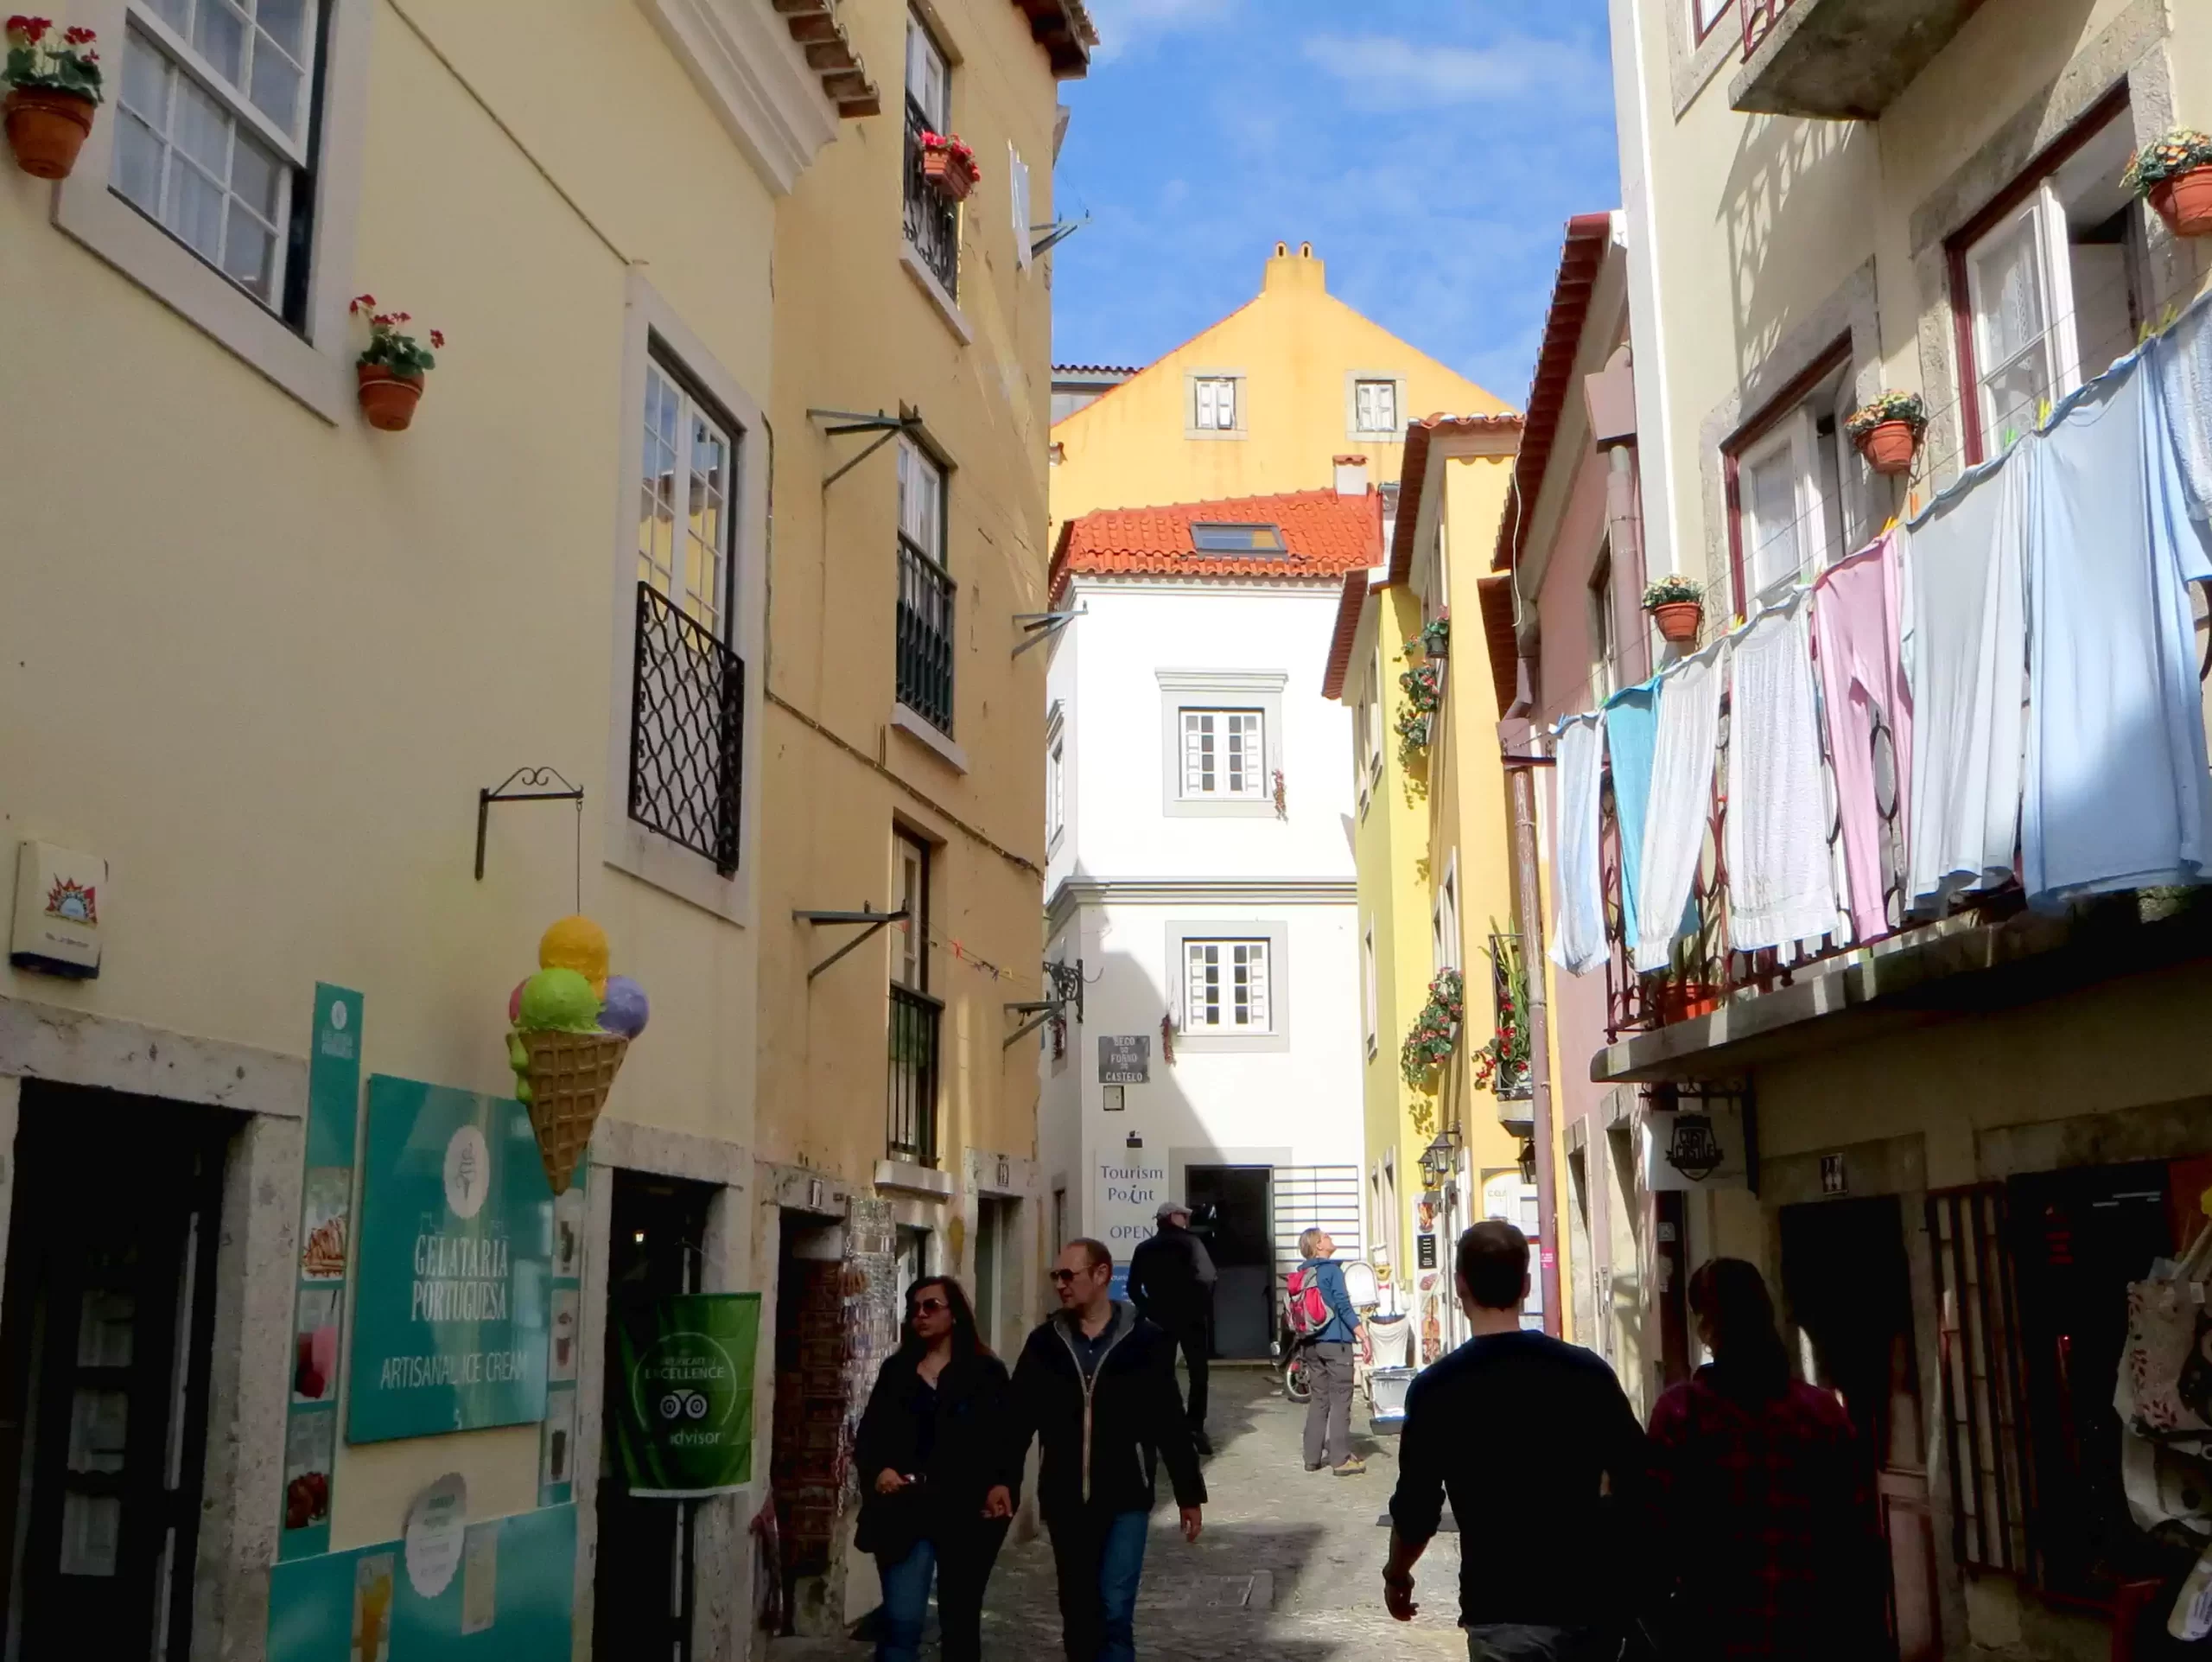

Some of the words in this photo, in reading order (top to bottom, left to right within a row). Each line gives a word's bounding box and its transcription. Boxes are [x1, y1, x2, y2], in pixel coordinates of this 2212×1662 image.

[1105, 1072, 1143, 1082] CASTELO
[1100, 1165, 1165, 1180] Tourism
[1108, 1185, 1155, 1204] Point
[1109, 1226, 1154, 1239] OPEN
[414, 1232, 509, 1277] GELATARIA
[410, 1280, 507, 1322] PORTUGUESA
[380, 1356, 456, 1390] ARTISANAL
[461, 1353, 482, 1384] ICE
[486, 1350, 528, 1383] CREAM
